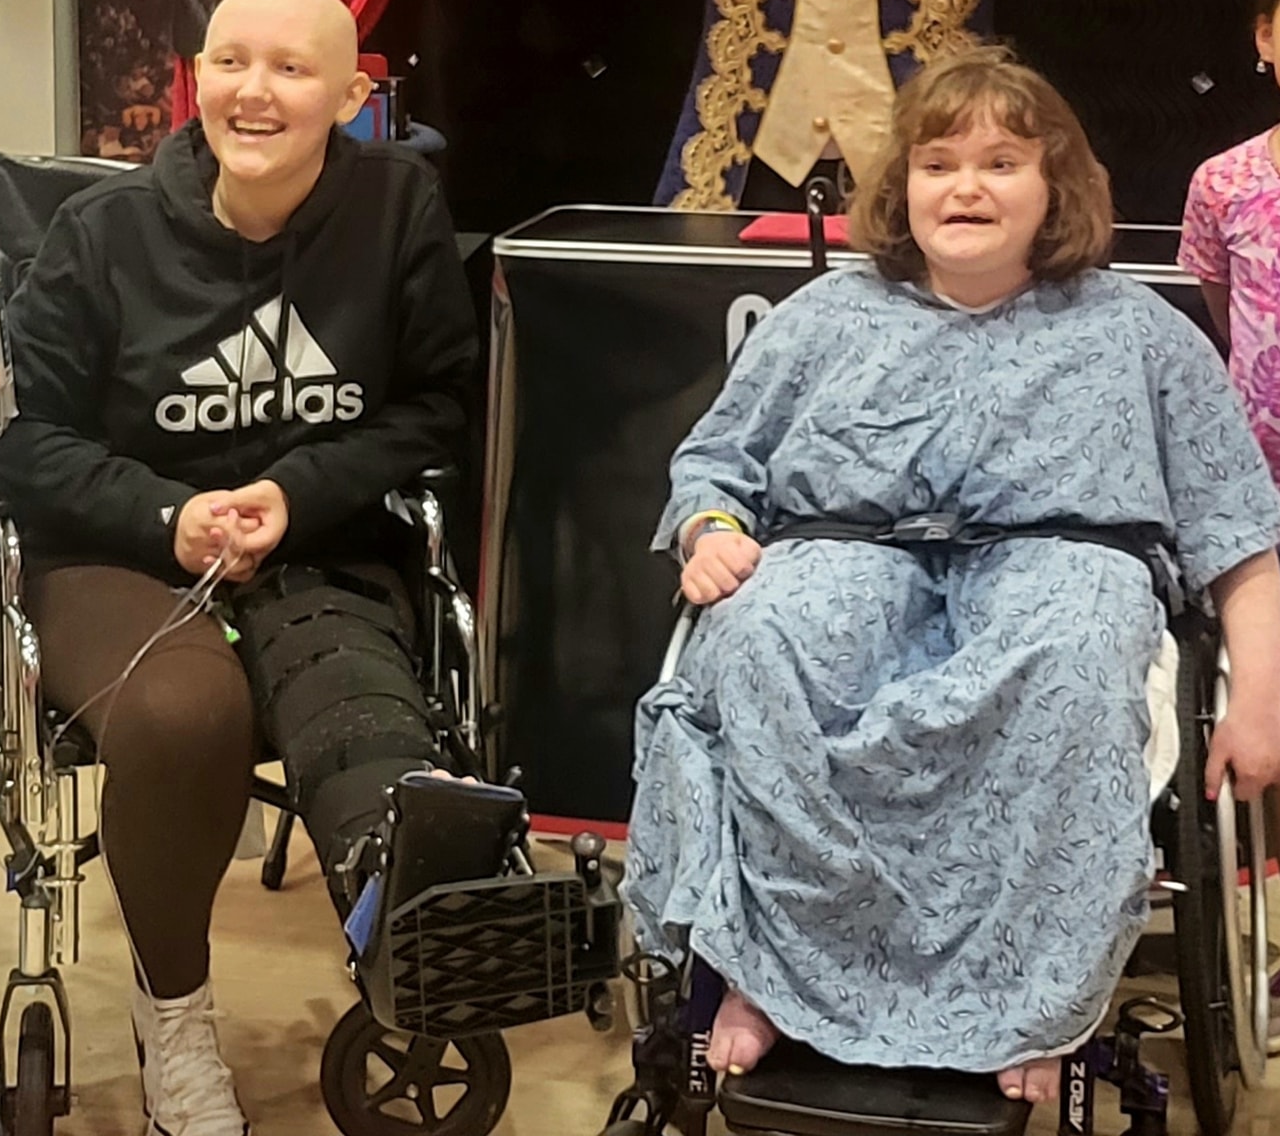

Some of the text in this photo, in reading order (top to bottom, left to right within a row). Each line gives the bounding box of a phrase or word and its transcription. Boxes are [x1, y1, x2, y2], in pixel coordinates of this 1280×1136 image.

[154, 376, 364, 432] adidas
[1069, 1061, 1086, 1133] AERO Z
